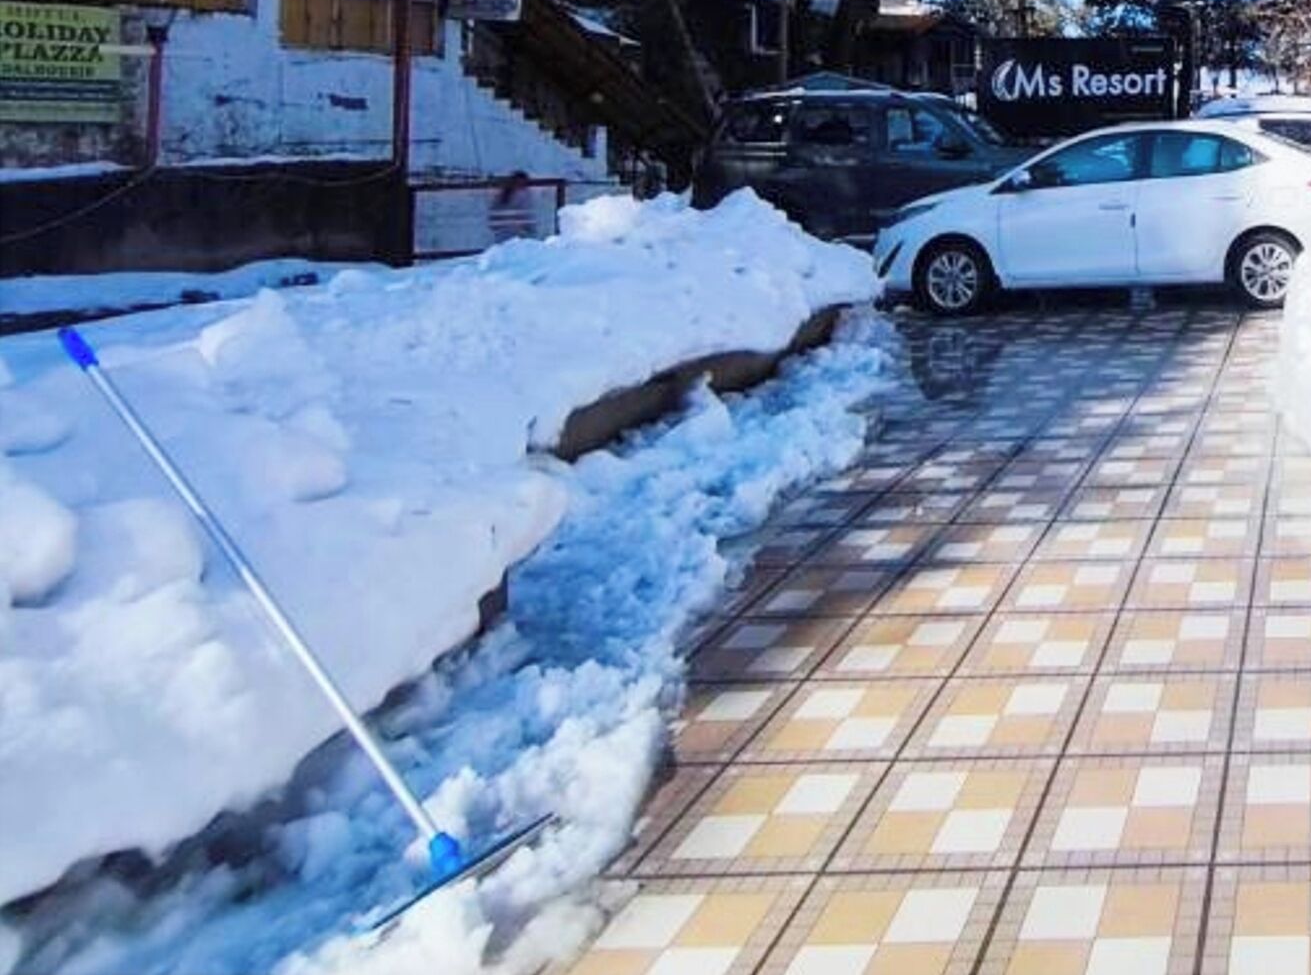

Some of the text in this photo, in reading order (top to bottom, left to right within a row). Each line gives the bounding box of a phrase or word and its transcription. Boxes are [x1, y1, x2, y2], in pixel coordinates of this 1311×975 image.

[0, 20, 110, 44] OLIDAY
[1013, 63, 1167, 97] Ms Resort
